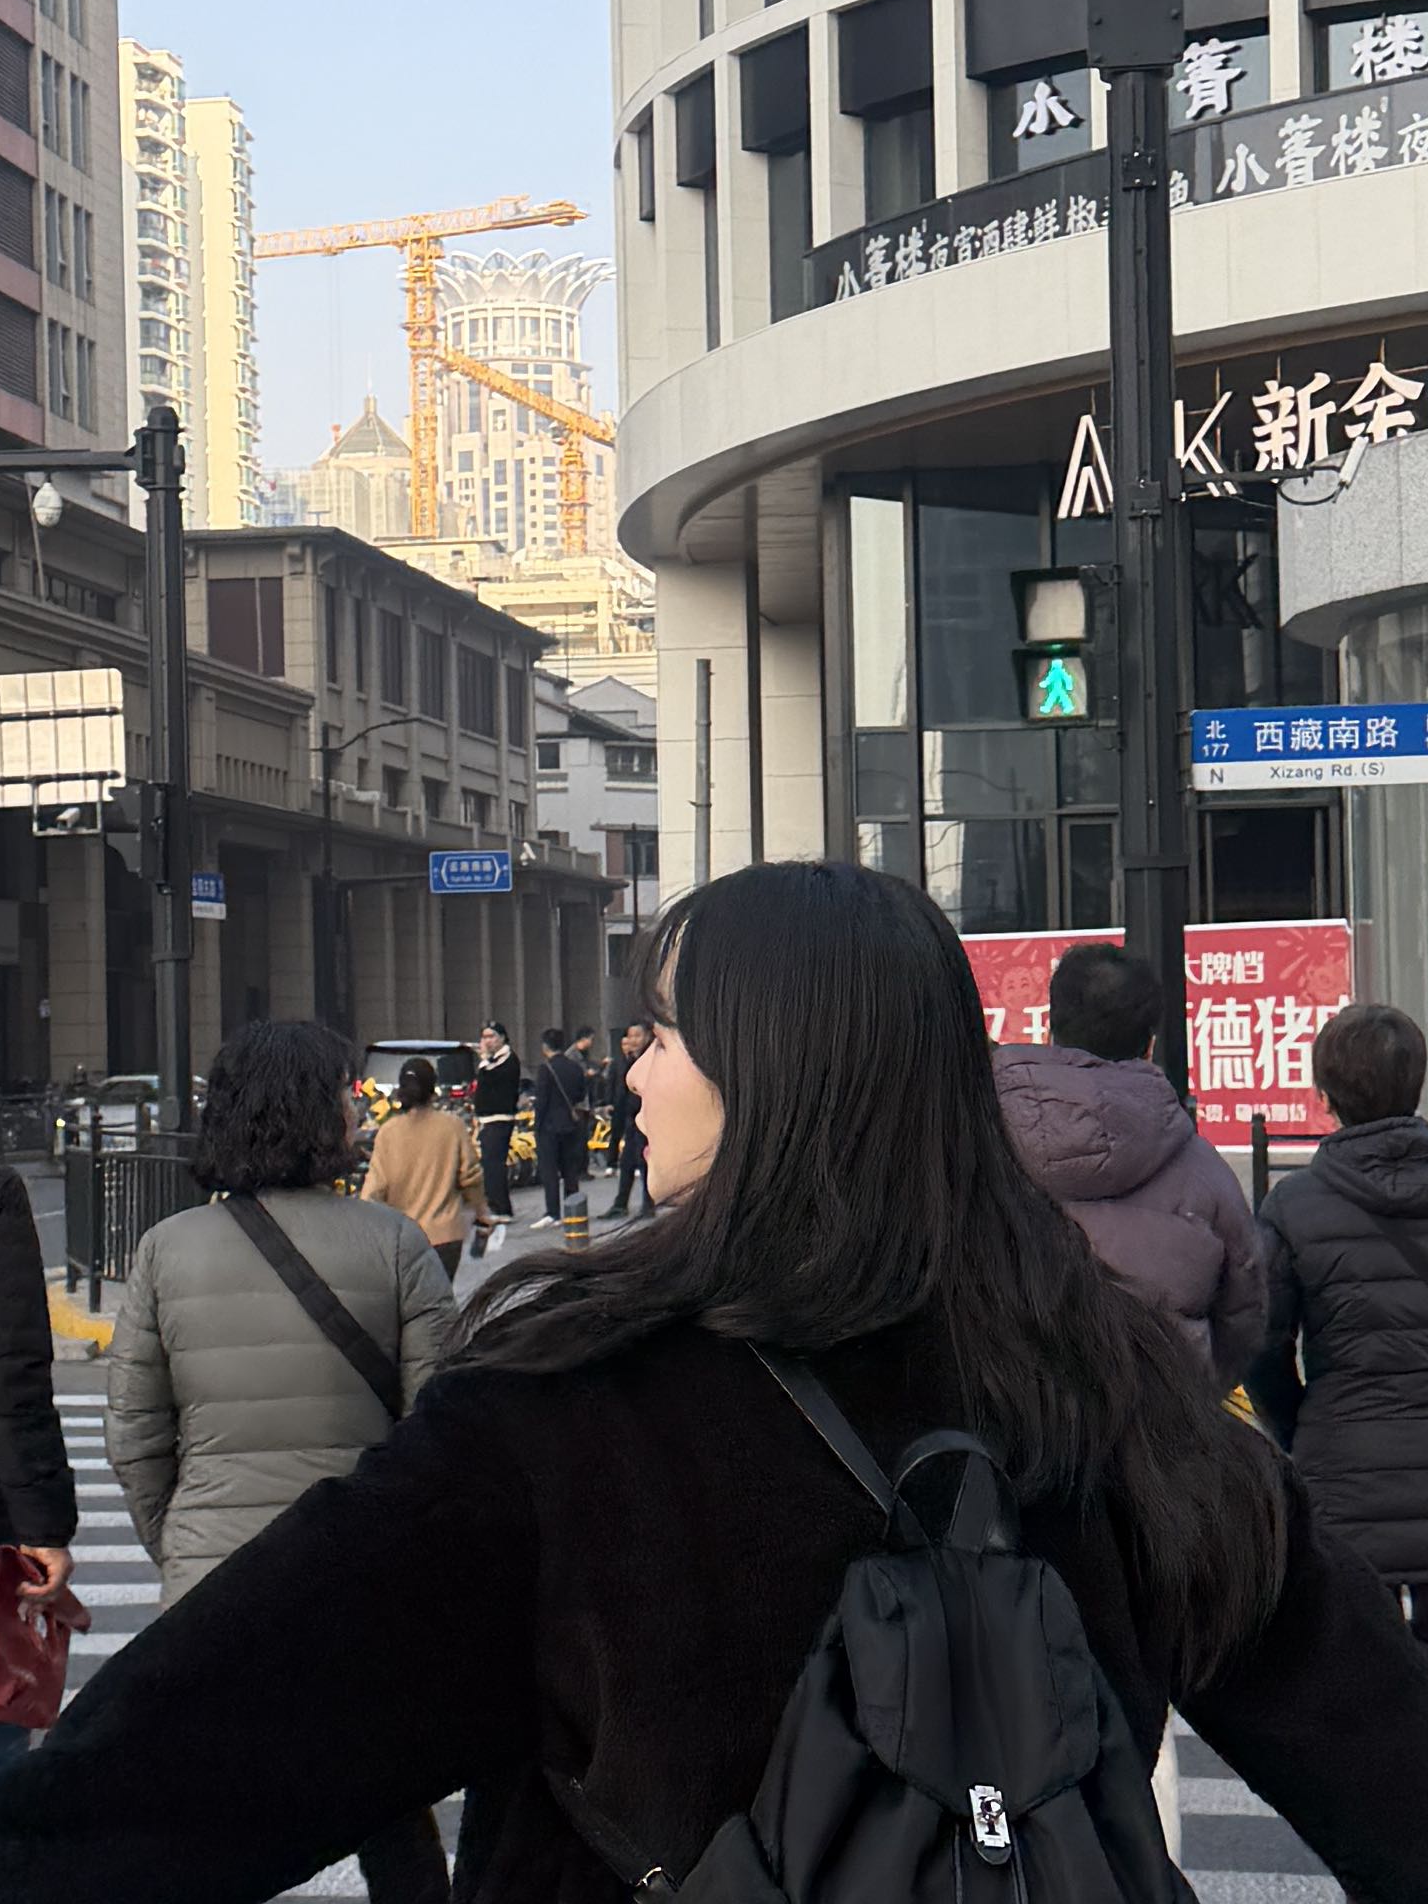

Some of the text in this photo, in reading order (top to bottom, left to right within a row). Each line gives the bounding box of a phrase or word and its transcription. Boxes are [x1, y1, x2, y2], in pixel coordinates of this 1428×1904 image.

[1206, 720, 1226, 740] 北
[1254, 716, 1399, 752] 西藏南路
[1202, 744, 1229, 757] 177
[1210, 769, 1224, 784] N
[1270, 765, 1323, 780] Xizang
[1187, 995, 1352, 1090] 德猪
